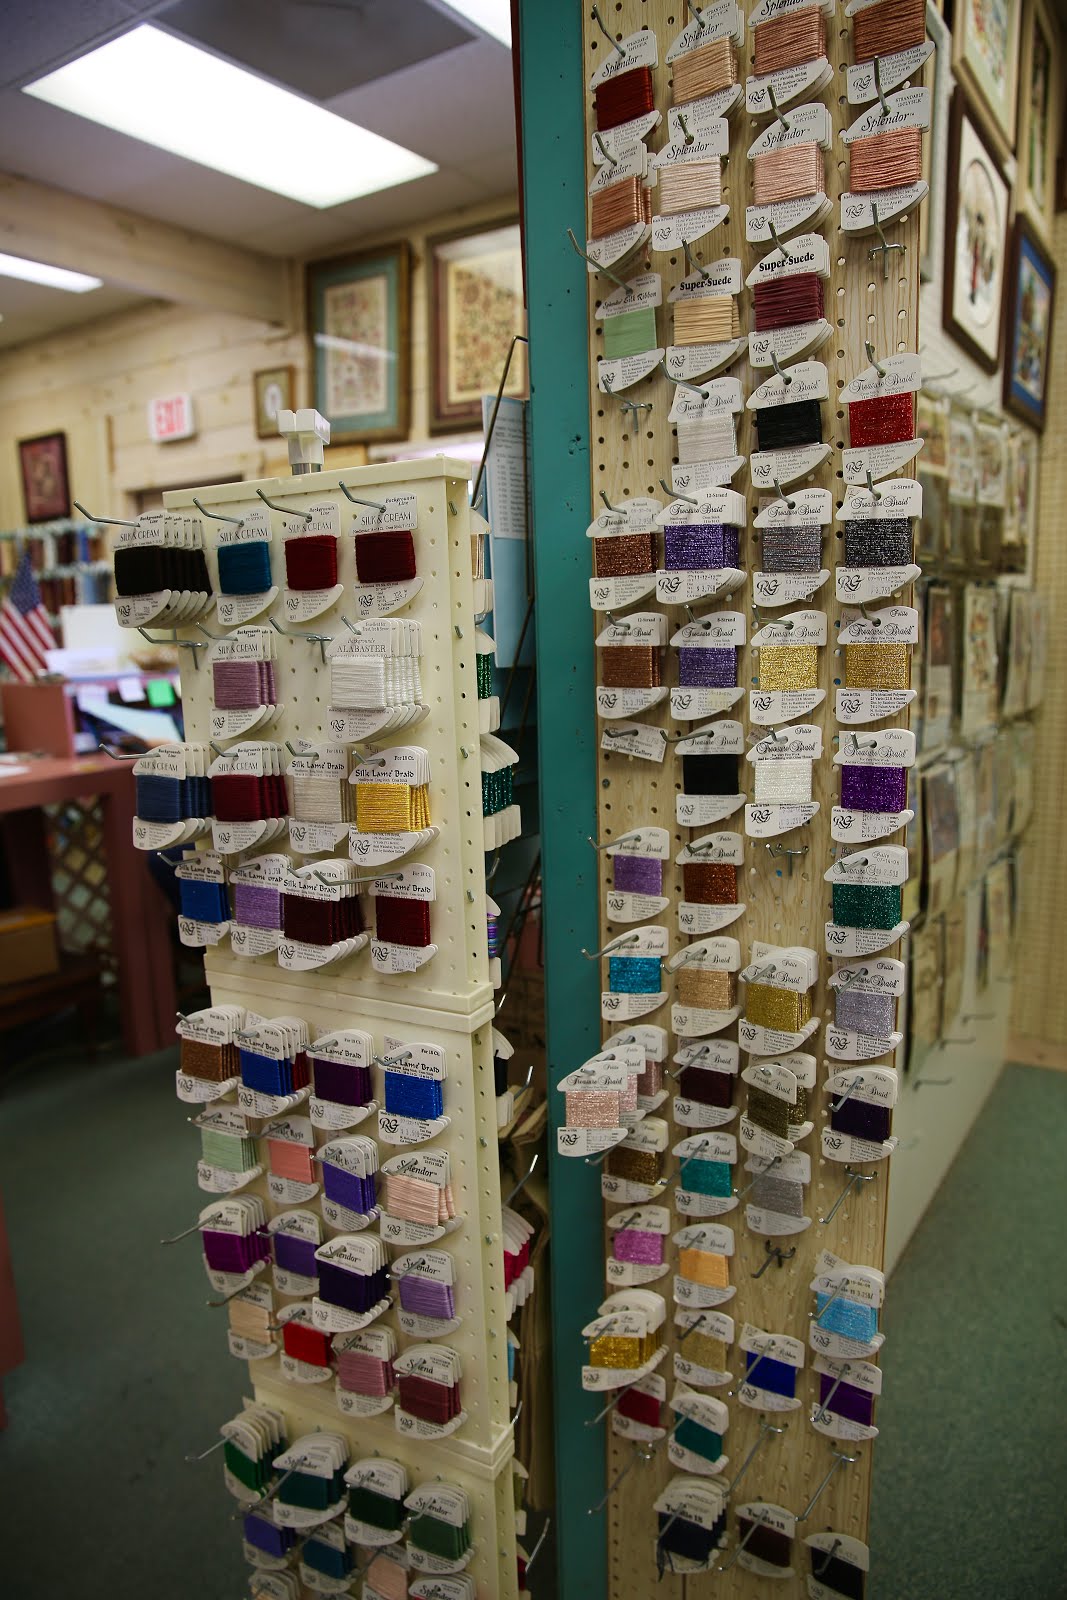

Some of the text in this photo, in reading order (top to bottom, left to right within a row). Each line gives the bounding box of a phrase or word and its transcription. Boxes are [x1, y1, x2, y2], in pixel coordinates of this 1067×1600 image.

[680, 23, 720, 48] Splendor
[602, 55, 639, 77] Splendor
[853, 75, 873, 91] RG
[861, 113, 910, 131] Splendor
[762, 129, 806, 148] Splendor
[667, 142, 709, 160] Splendor
[759, 252, 815, 272] Super-Suede
[680, 276, 732, 291] Super-Suede
[637, 291, 657, 301] Ribbon
[791, 380, 818, 393] Braid
[883, 495, 909, 507] Braid
[669, 503, 724, 515] Treasure Braid
[798, 504, 821, 515] Braid
[361, 516, 377, 525] SILK
[383, 512, 411, 522] CREAM
[241, 528, 268, 538] CREAM
[308, 522, 332, 531] CREAM
[138, 529, 160, 539] CREAM
[659, 576, 684, 593] RG
[757, 579, 782, 596] RG
[838, 574, 865, 596] RG
[711, 627, 733, 637] Braid
[761, 626, 820, 639] Treasure Braid
[849, 623, 913, 637] Treasure Braid
[236, 643, 258, 652] CREAM
[337, 645, 386, 653] ALABASTER
[599, 694, 618, 708] RG
[671, 695, 693, 710] RG
[753, 696, 774, 711] RG
[841, 699, 863, 714] RG
[635, 748, 652, 757] Gallery
[756, 740, 816, 753] Treasure Braid
[292, 761, 304, 769] Silk
[327, 762, 345, 770] Braid
[355, 770, 370, 778] Silk
[395, 770, 414, 778] Braid
[751, 809, 773, 823] RG
[833, 815, 855, 829] RG
[291, 827, 307, 842] RG
[352, 839, 372, 855] RG
[284, 879, 297, 888] Silk
[319, 884, 337, 893] Braid
[375, 881, 388, 889] Silk
[411, 884, 430, 893] Braid
[828, 931, 849, 944] RG
[279, 944, 295, 959] RG
[372, 946, 390, 961] RG
[210, 1027, 225, 1037] Braid
[265, 1043, 280, 1052] Braid
[830, 1036, 850, 1050] RG
[345, 1050, 362, 1059] Braid
[421, 1064, 440, 1073] Braid
[566, 1076, 622, 1086] Treasure Braid
[380, 1118, 399, 1133] RG
[560, 1134, 580, 1145] RG
[404, 1258, 436, 1275] Spendor
